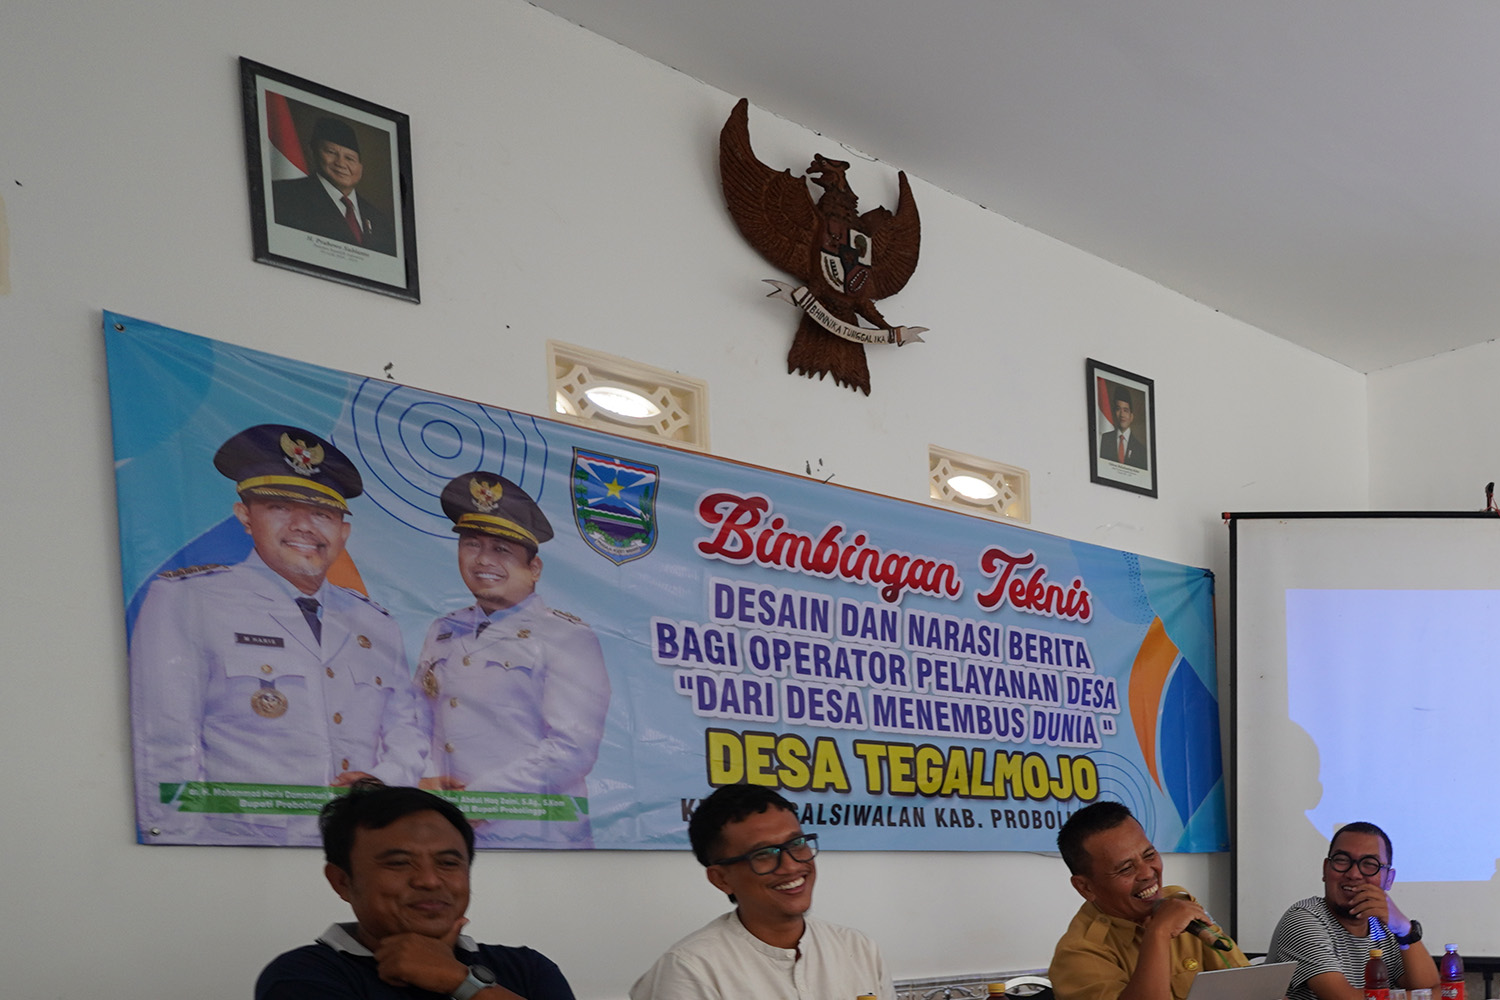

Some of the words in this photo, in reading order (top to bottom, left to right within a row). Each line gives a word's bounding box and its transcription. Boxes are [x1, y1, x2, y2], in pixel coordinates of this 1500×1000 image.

[698, 493, 960, 603] Bimbingan
[977, 548, 1091, 620] Teknis
[656, 621, 738, 667] BAGI
[749, 634, 908, 687] OPERATOR
[916, 657, 1059, 703] PELAYANAN
[1066, 675, 1117, 710] DESA
[714, 582, 829, 634] DESAIN
[841, 602, 897, 643] DAN
[908, 613, 1000, 658] NARASI
[1008, 630, 1092, 670] BERITA
[679, 674, 774, 717] "DARI
[786, 684, 863, 726] DESA
[873, 694, 1025, 739] MENEMBUS
[1032, 709, 1099, 745] DUNIA
[706, 728, 851, 793] DESA
[853, 739, 1100, 802] TEGALMOJO
[793, 801, 926, 828] ALSIWALAN
[934, 807, 983, 828] KAB.
